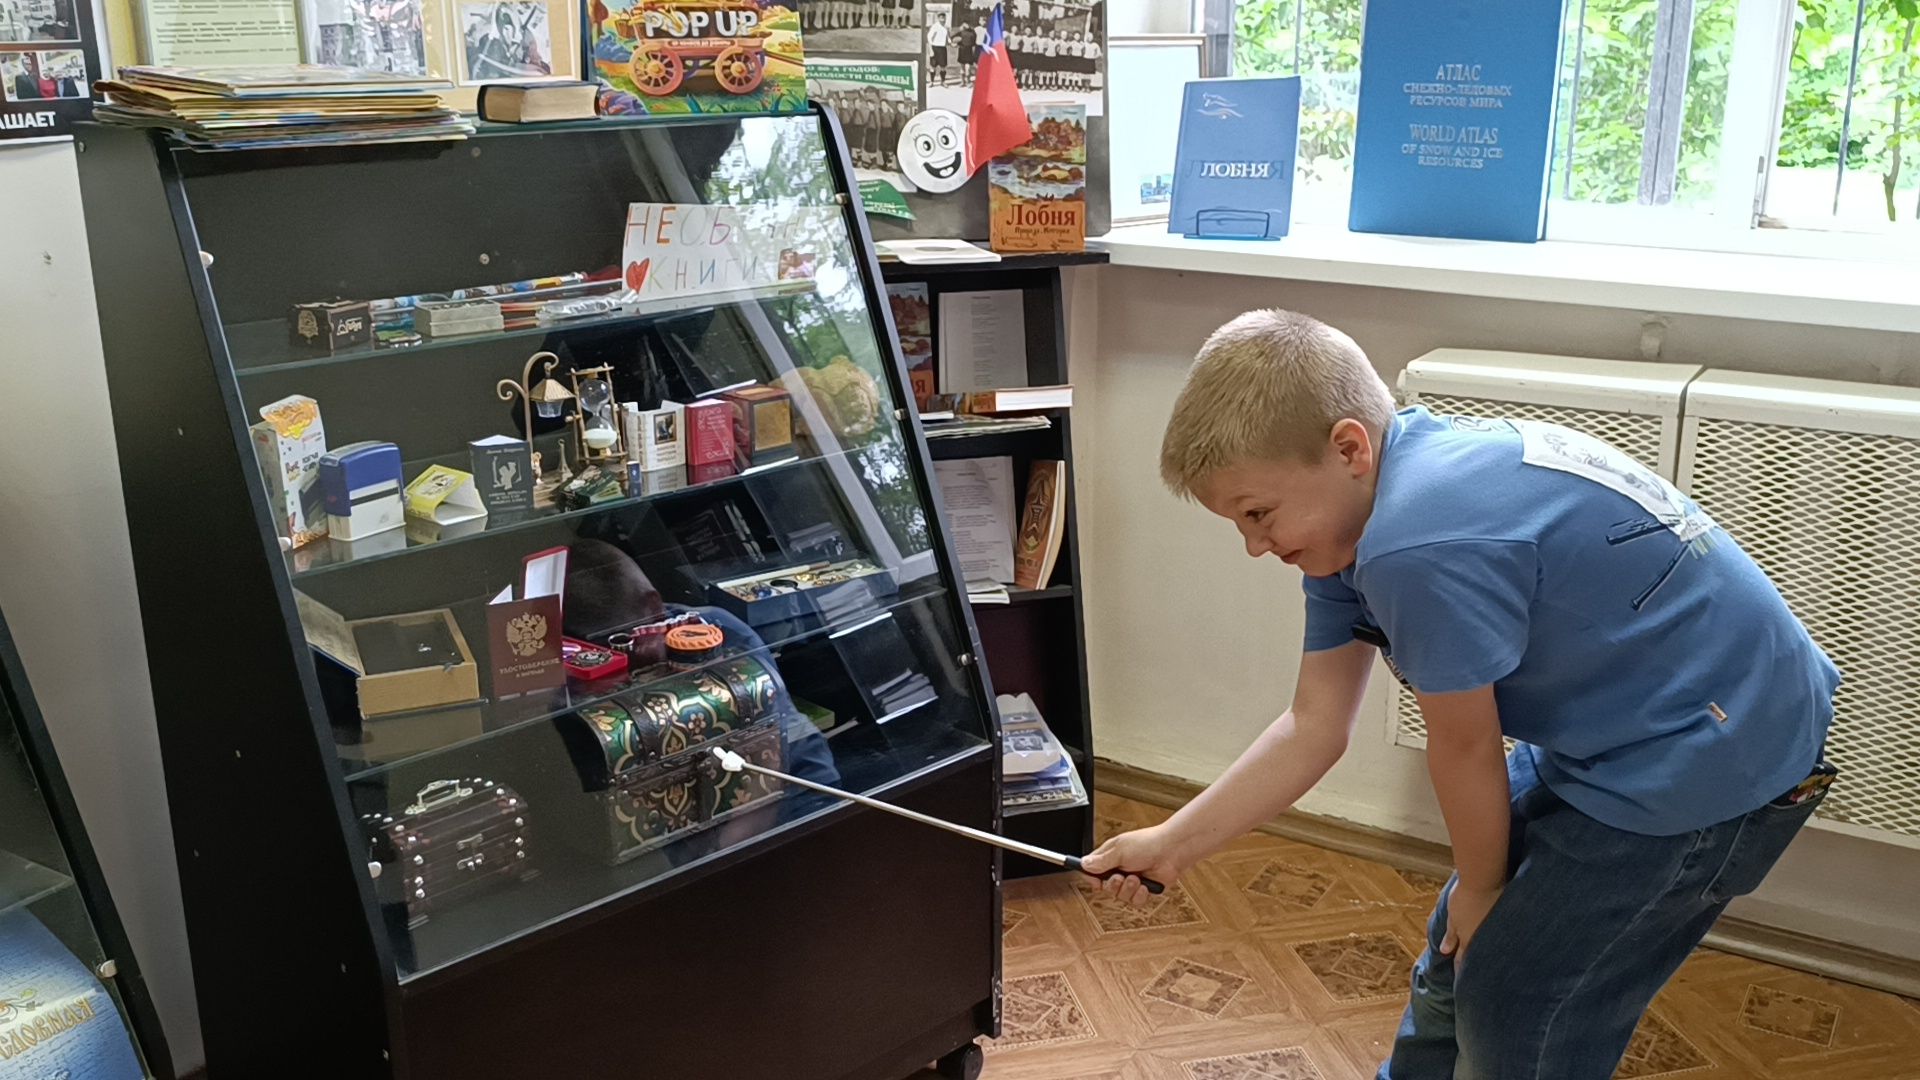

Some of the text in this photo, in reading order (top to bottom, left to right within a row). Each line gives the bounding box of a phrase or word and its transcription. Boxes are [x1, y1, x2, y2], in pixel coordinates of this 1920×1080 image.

[644, 10, 758, 37] POP UP
[806, 72, 911, 86] ОЛОДОСТИ ПОЛЯНЫ
[1435, 64, 1482, 81] АТЛАС
[1403, 82, 1512, 97] СНЕЖНО-ЛЕДОВЫХ
[1409, 95, 1504, 108] РЕСУРСОВ МИРА
[1409, 123, 1499, 145] WORLD ATLAS
[1401, 143, 1504, 159] OF SNOW AND ICE
[1200, 162, 1270, 178] ЛОБНЯ
[1418, 156, 1484, 169] RESOURCES
[1006, 203, 1077, 226] Лобня
